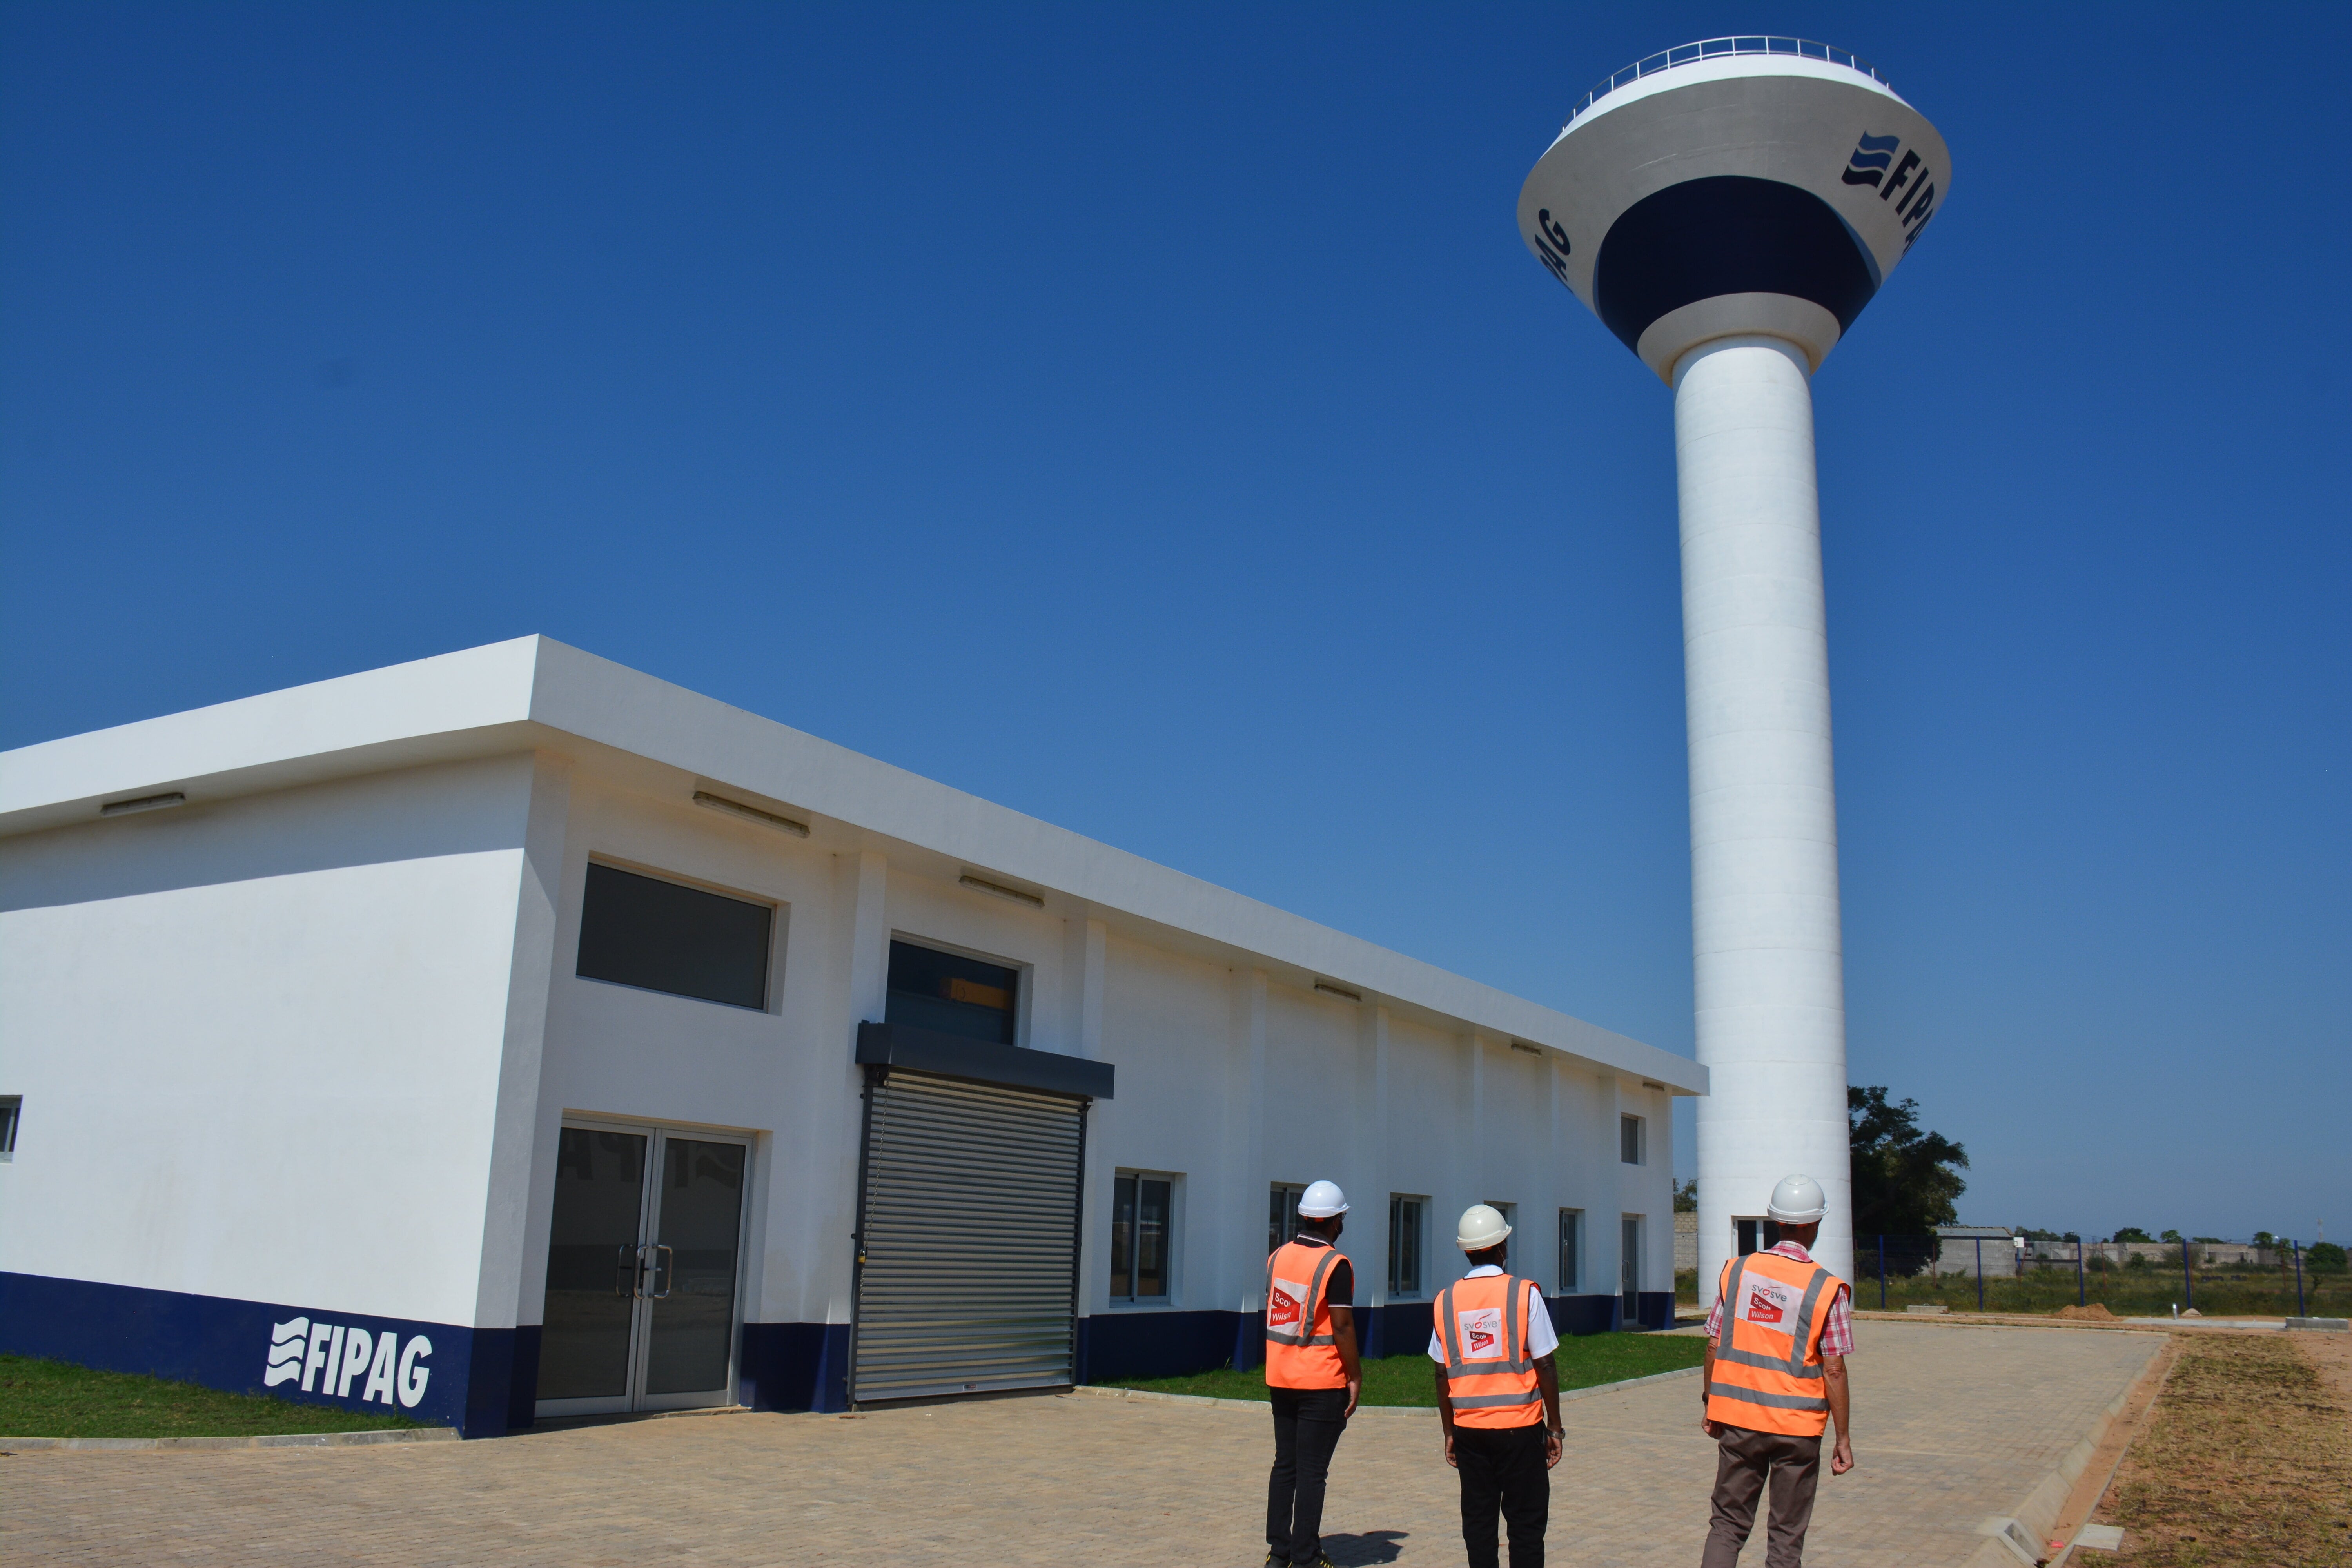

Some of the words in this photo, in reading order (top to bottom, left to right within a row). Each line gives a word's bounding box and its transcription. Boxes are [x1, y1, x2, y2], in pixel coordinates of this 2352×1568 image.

[1879, 149, 1934, 265] FIPA
[1751, 1310, 1774, 1319] Wilson
[301, 1323, 432, 1408] FIPAG
[1474, 1339, 1488, 1350] Wilson
